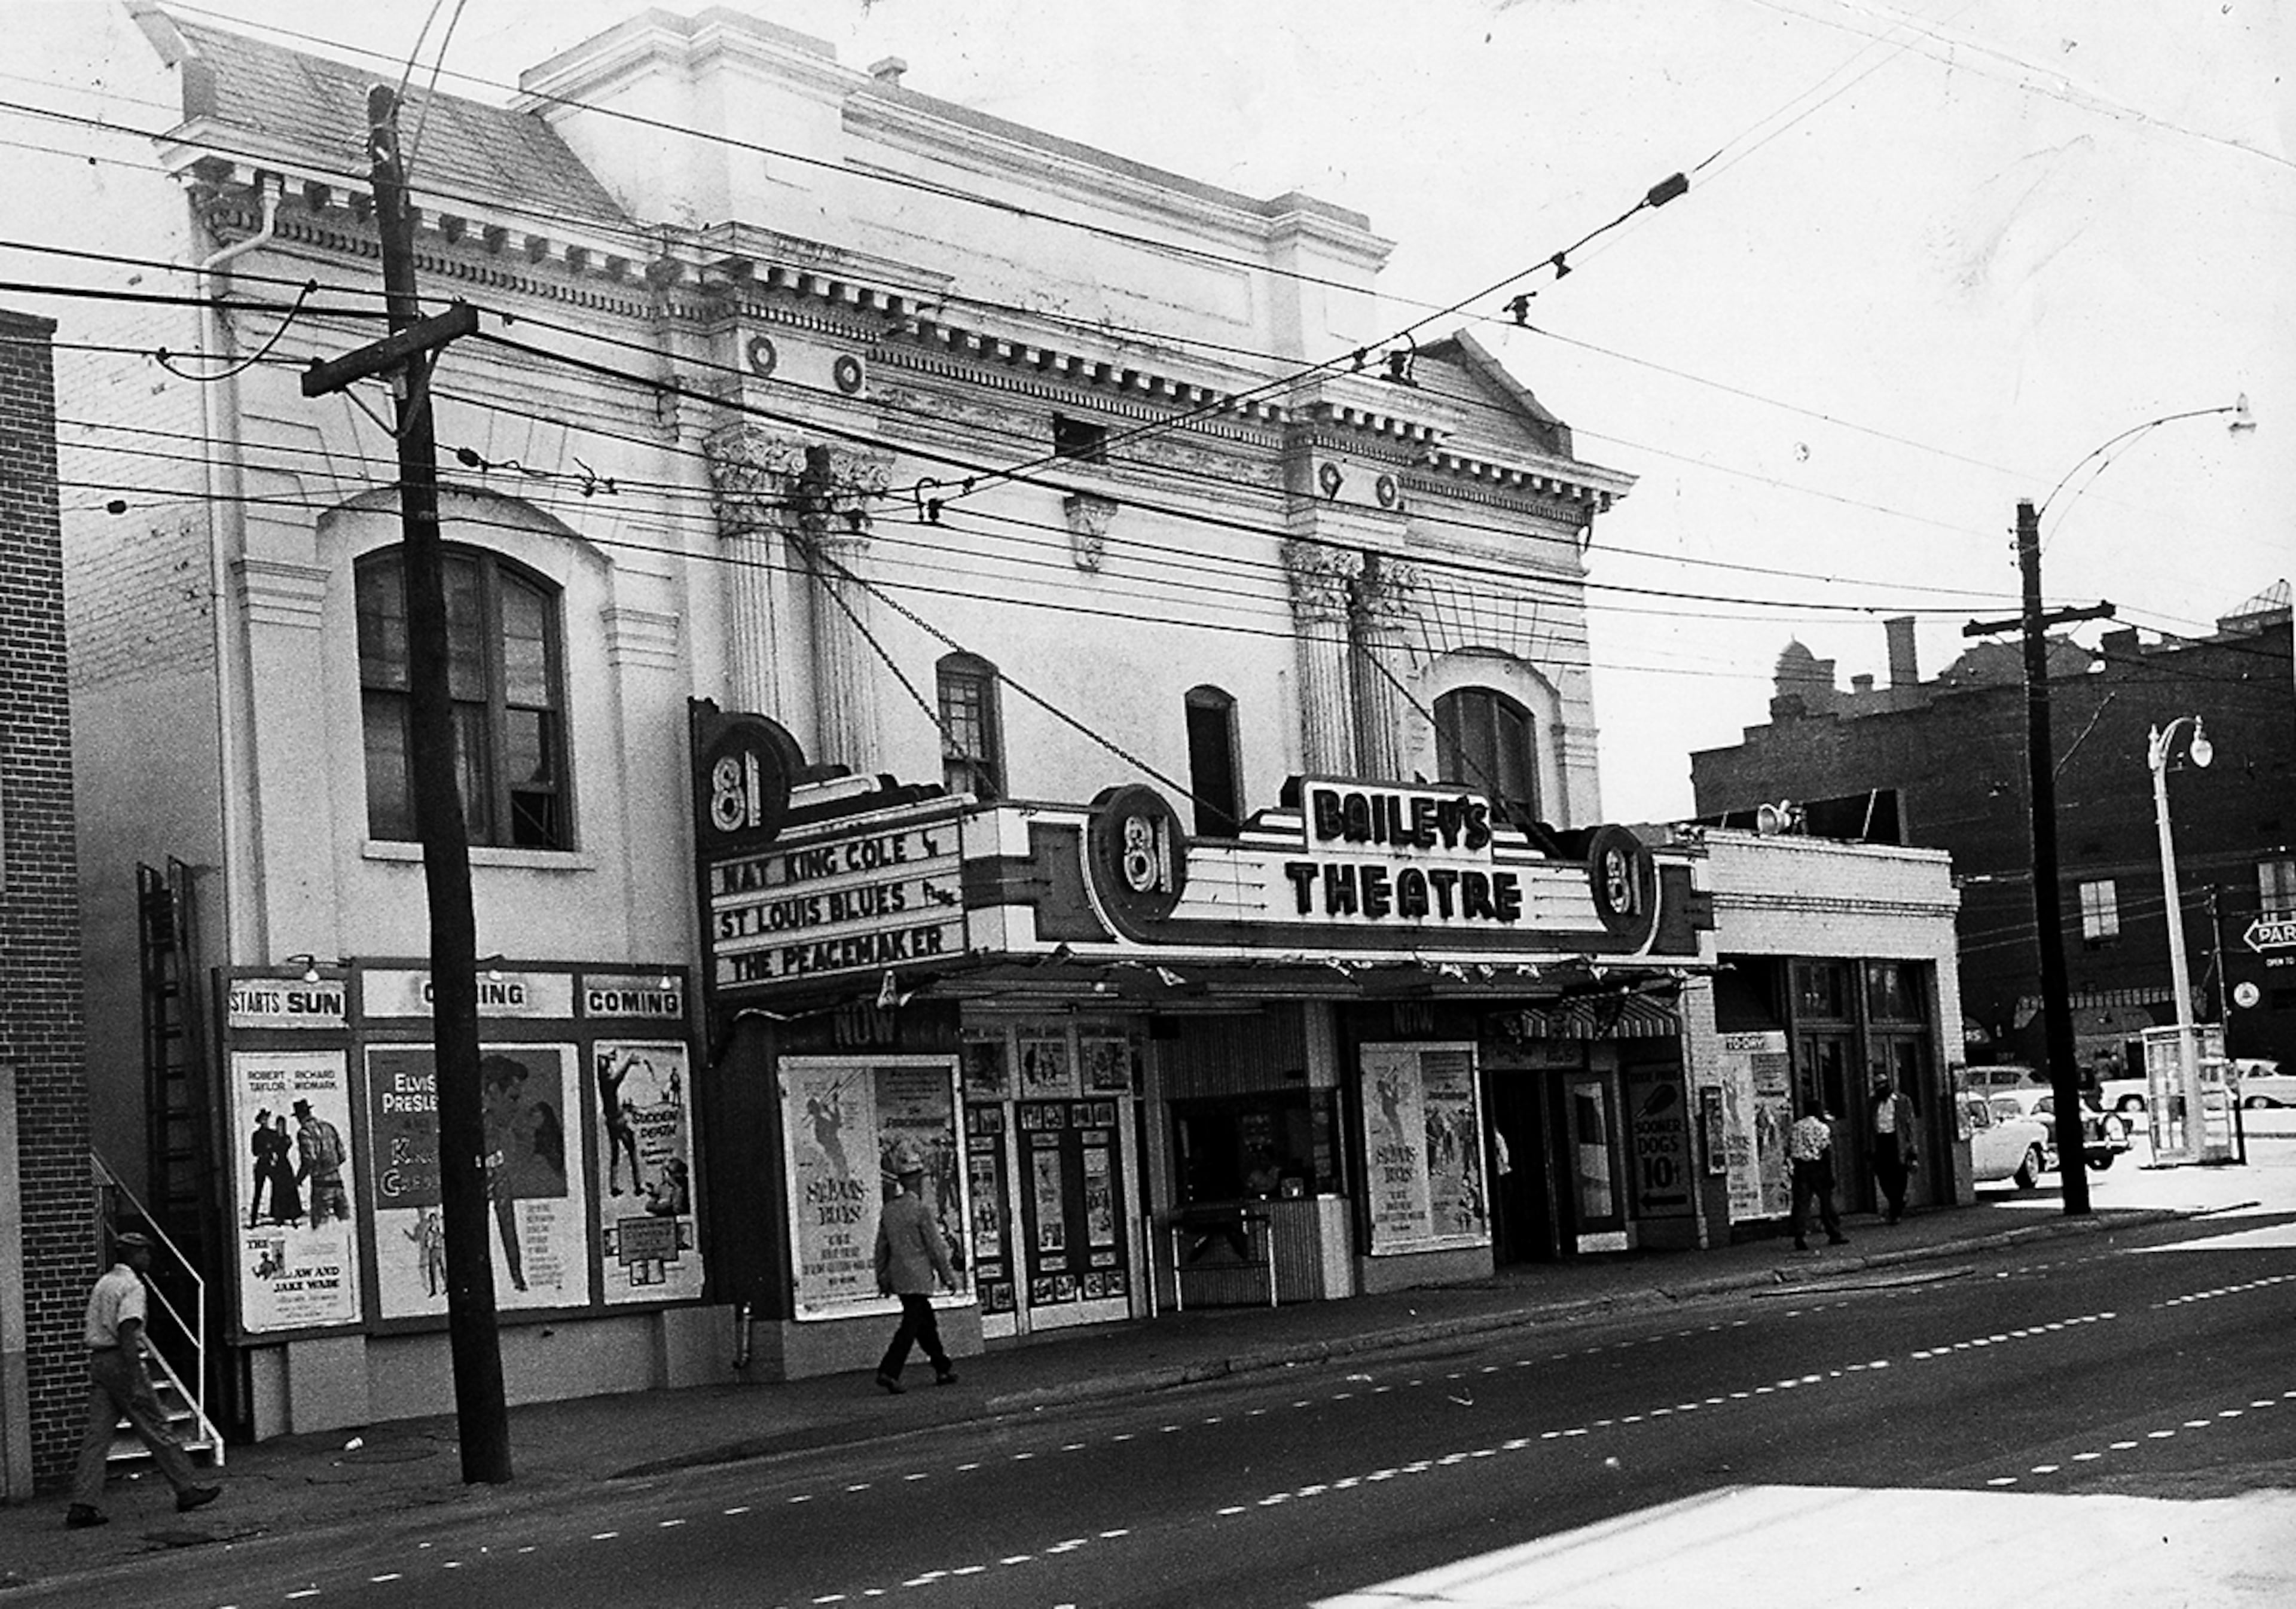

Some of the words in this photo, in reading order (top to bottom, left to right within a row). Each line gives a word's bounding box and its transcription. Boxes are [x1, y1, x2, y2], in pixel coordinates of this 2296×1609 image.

[710, 750, 761, 832] 81
[1313, 789, 1491, 851] BAILEY'S
[723, 859, 768, 892] NAT
[785, 848, 837, 882] KING
[847, 834, 906, 873] COLE
[1124, 815, 1173, 893] 81
[1606, 847, 1641, 915] 81
[721, 908, 747, 938] ST
[758, 897, 822, 931] LOUIS
[830, 881, 905, 922] BLUES
[1285, 862, 1522, 924] THEATRE
[732, 954, 772, 982] THE
[783, 926, 944, 975] PEACEMAKER
[231, 992, 280, 1013] STARTS
[287, 993, 341, 1014] SUN
[425, 984, 523, 1005] CING
[589, 993, 679, 1015] COMING
[834, 1002, 895, 1046] NOW
[382, 1092, 438, 1114] PRESLE
[395, 1073, 436, 1092] ELVIS
[1638, 1137, 1678, 1154] DOGS
